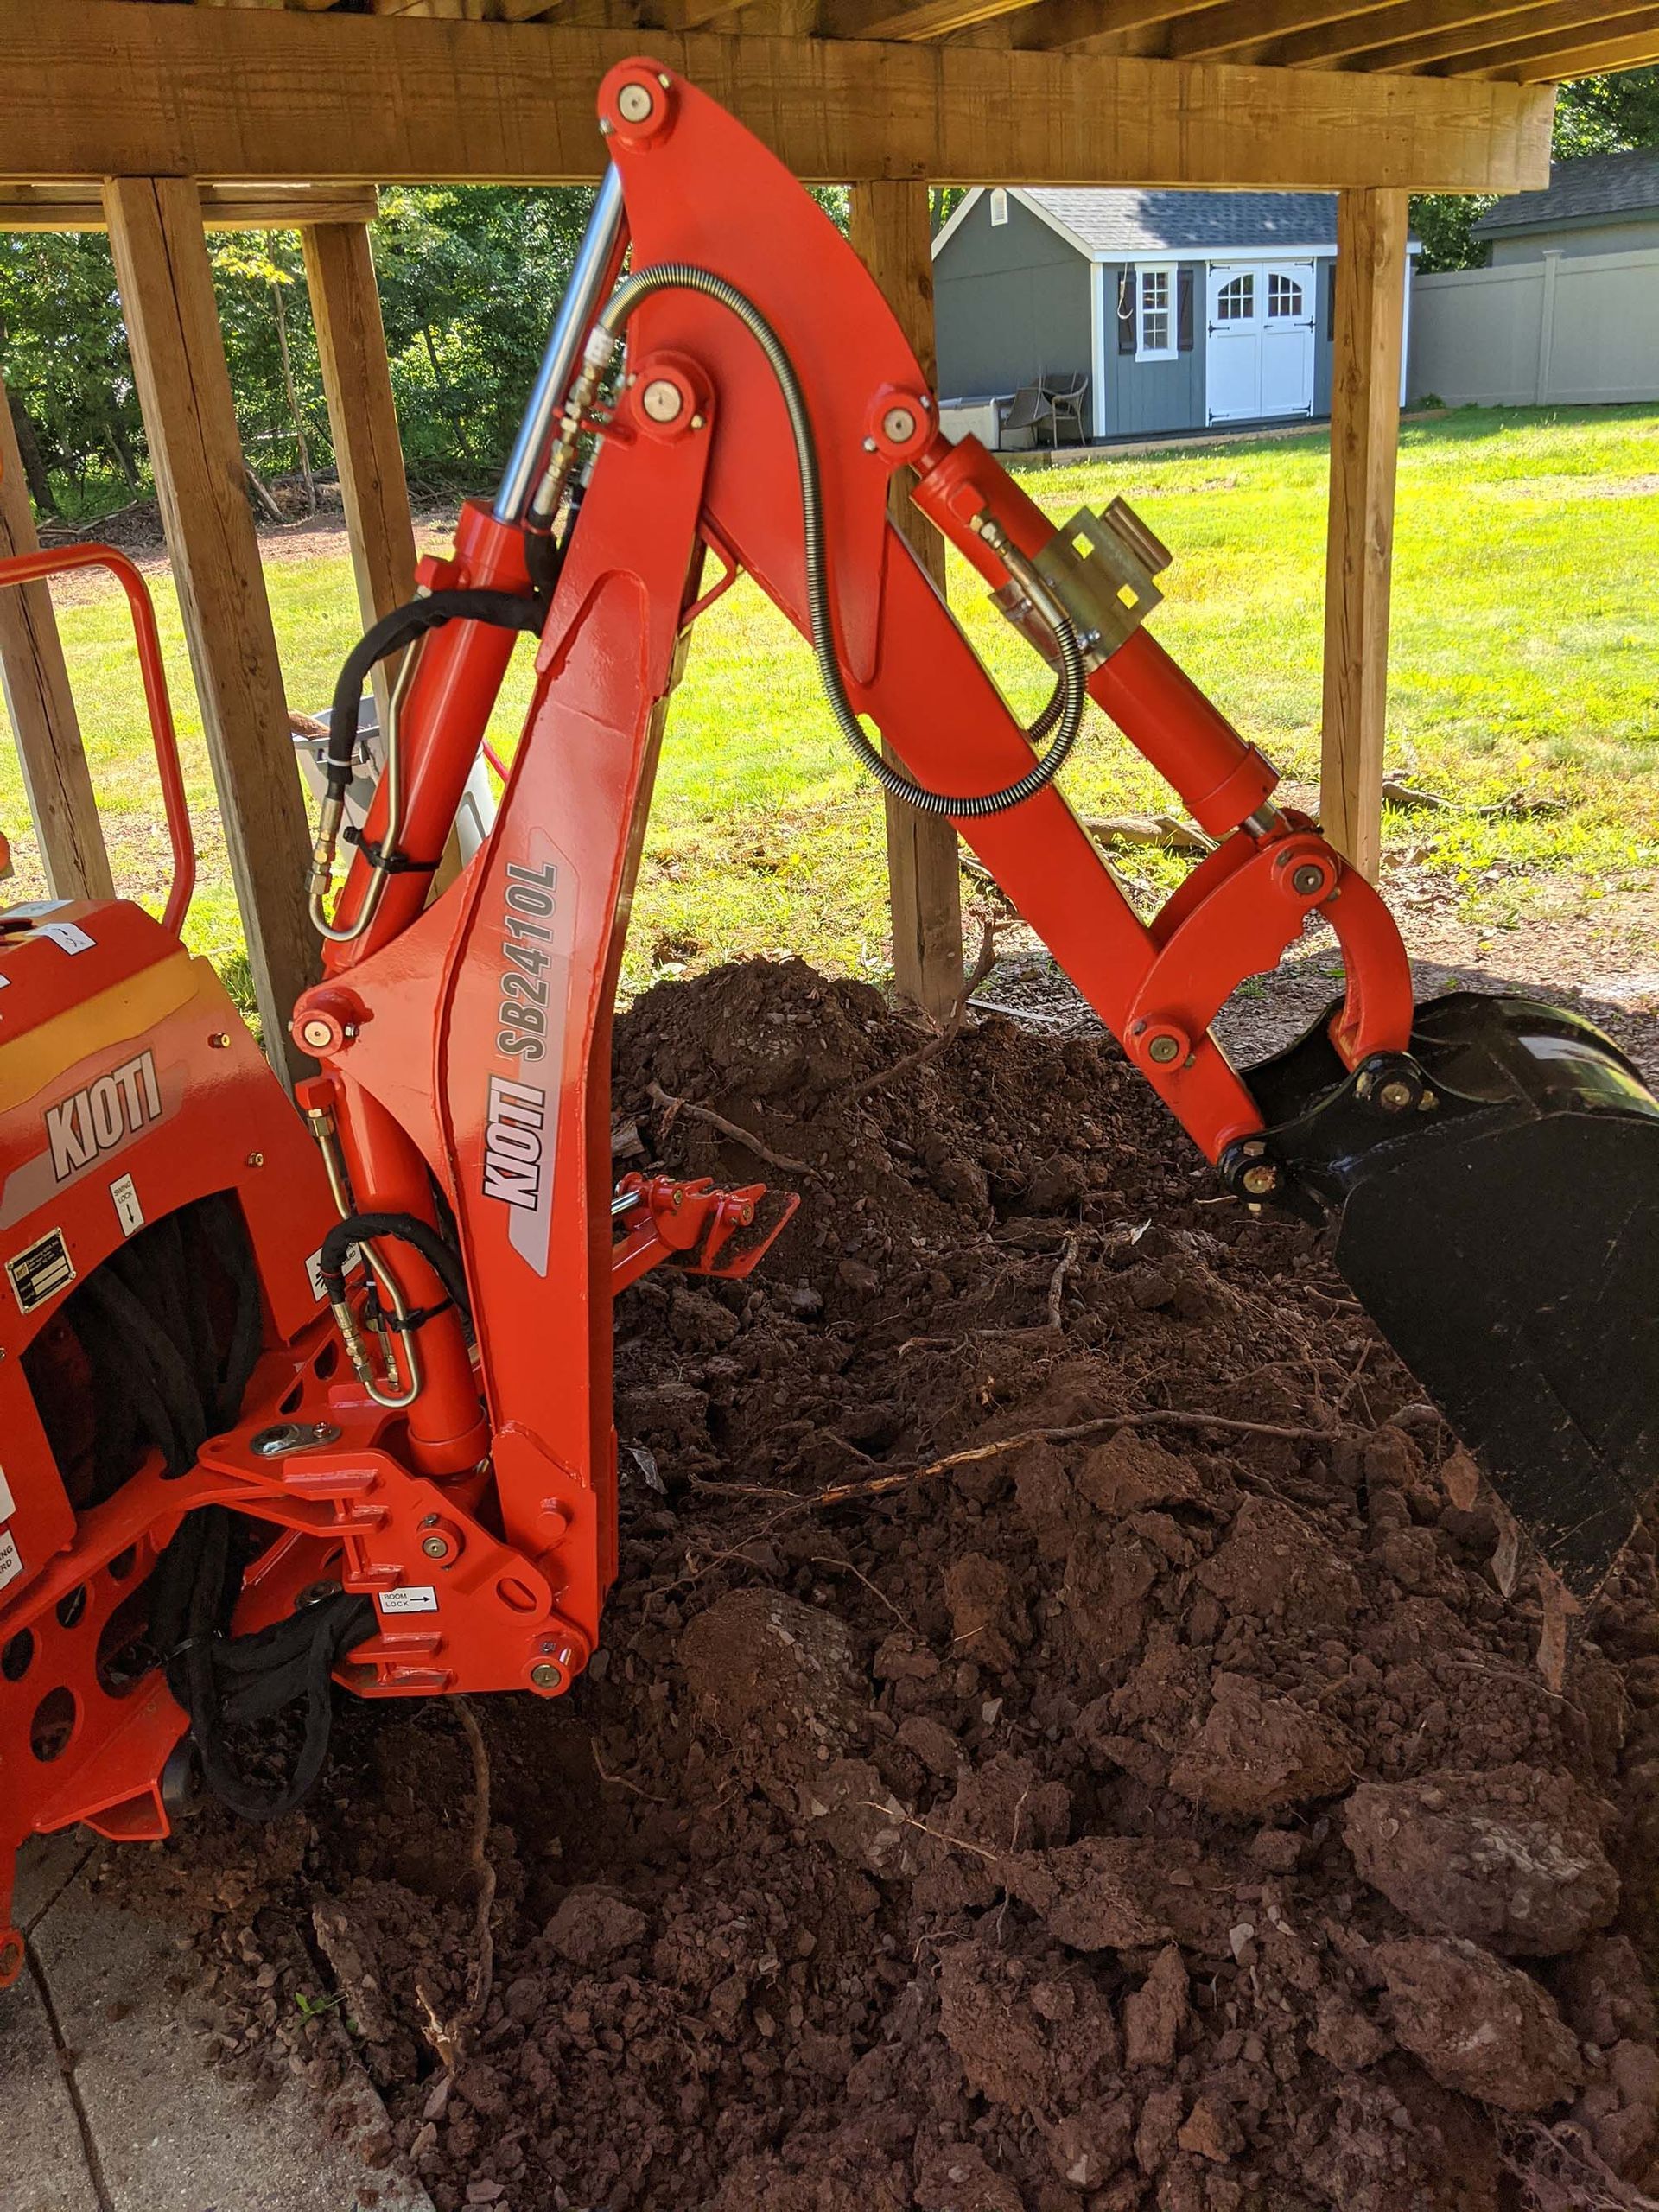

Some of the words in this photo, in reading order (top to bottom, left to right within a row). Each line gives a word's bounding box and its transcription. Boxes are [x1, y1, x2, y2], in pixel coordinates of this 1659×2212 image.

[496, 862, 556, 1062] SB2410L
[45, 1048, 162, 1183] KIOTI
[482, 1074, 545, 1211] KIOTI
[113, 1180, 132, 1197] SWING
[118, 1191, 133, 1204] LOCK
